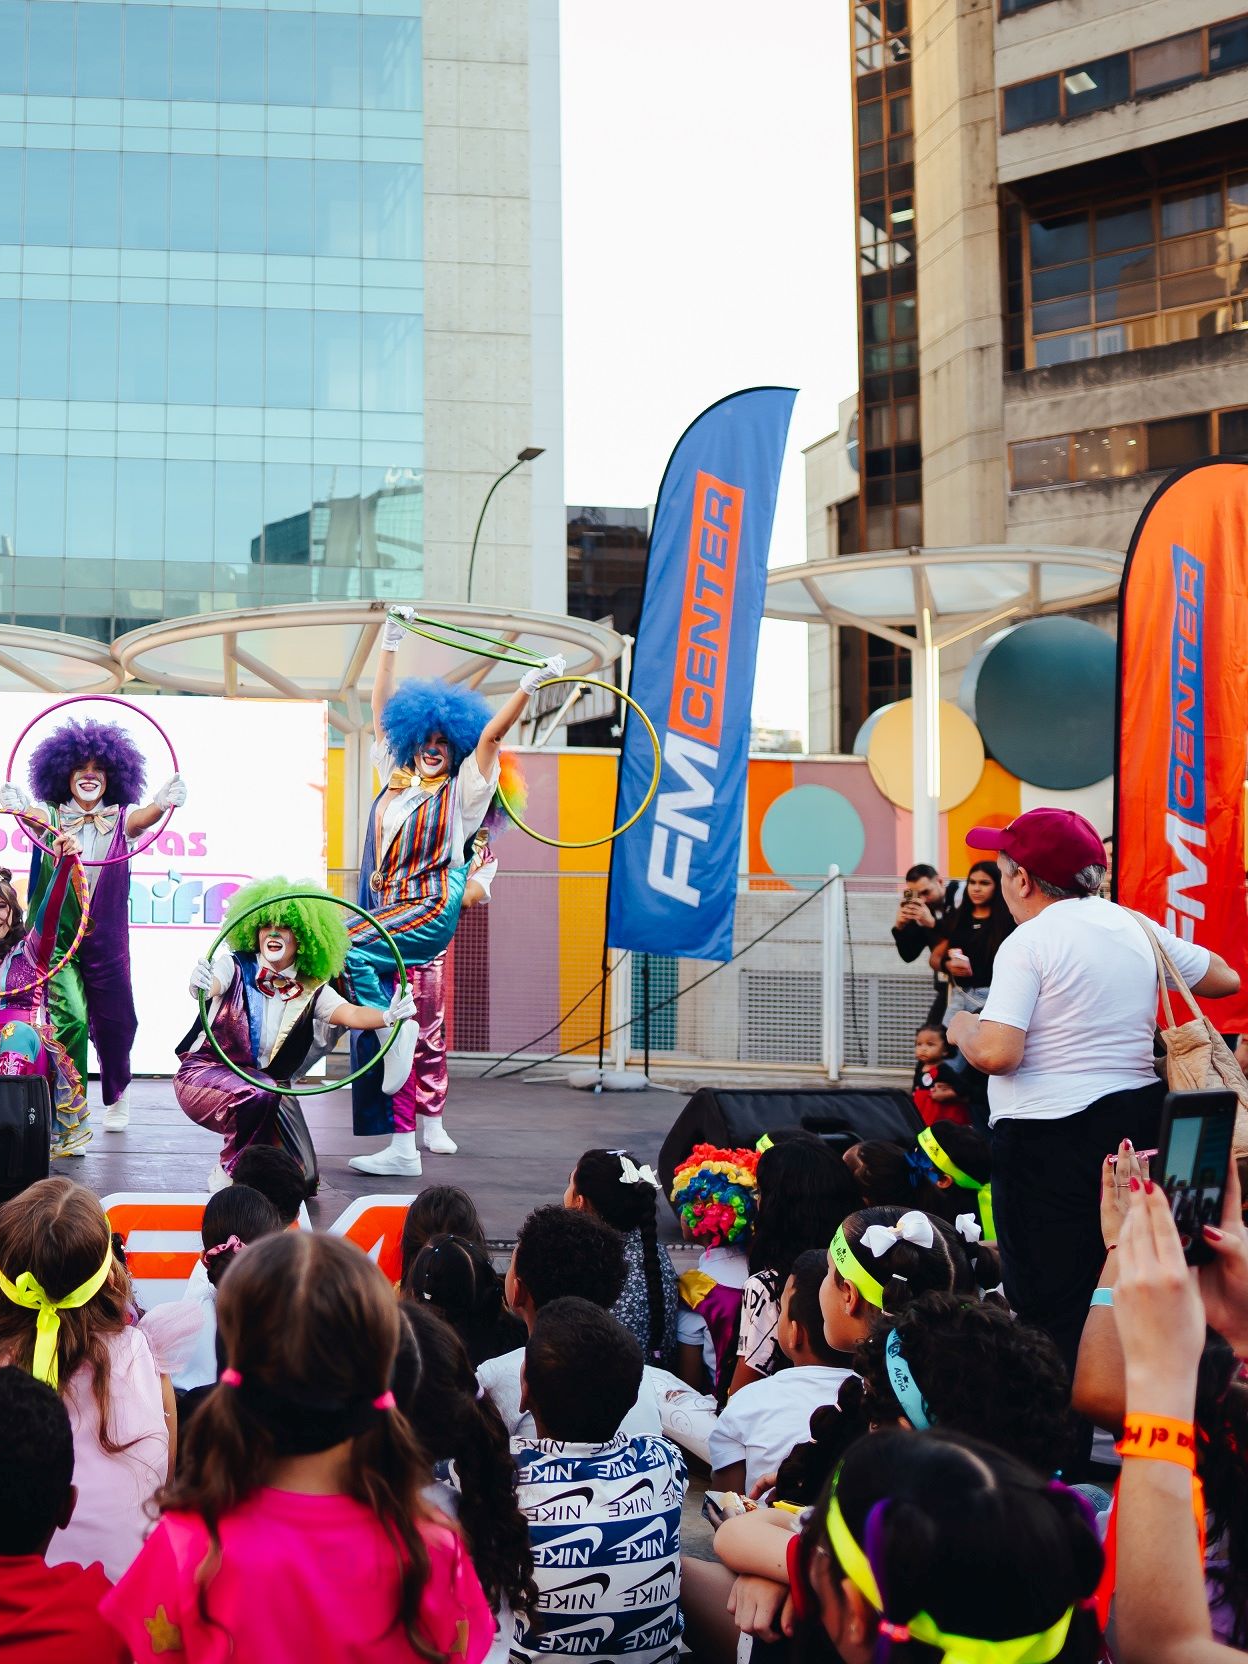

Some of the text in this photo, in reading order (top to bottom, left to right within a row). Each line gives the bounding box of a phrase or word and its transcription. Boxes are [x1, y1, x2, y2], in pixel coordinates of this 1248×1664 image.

[1173, 560, 1200, 809] CENTER
[647, 487, 732, 908] FM CENTER
[894, 1367, 906, 1392] Alma
[518, 1463, 573, 1482] NIKE
[526, 1504, 581, 1522] NIKE
[609, 1496, 652, 1518] NIKE
[533, 1546, 590, 1566] NIKE
[616, 1537, 664, 1562] NIKE
[537, 1593, 596, 1610] NIKE
[624, 1582, 671, 1608] NIKE
[539, 1635, 599, 1653] NIKE
[624, 1624, 671, 1651] NIKE
